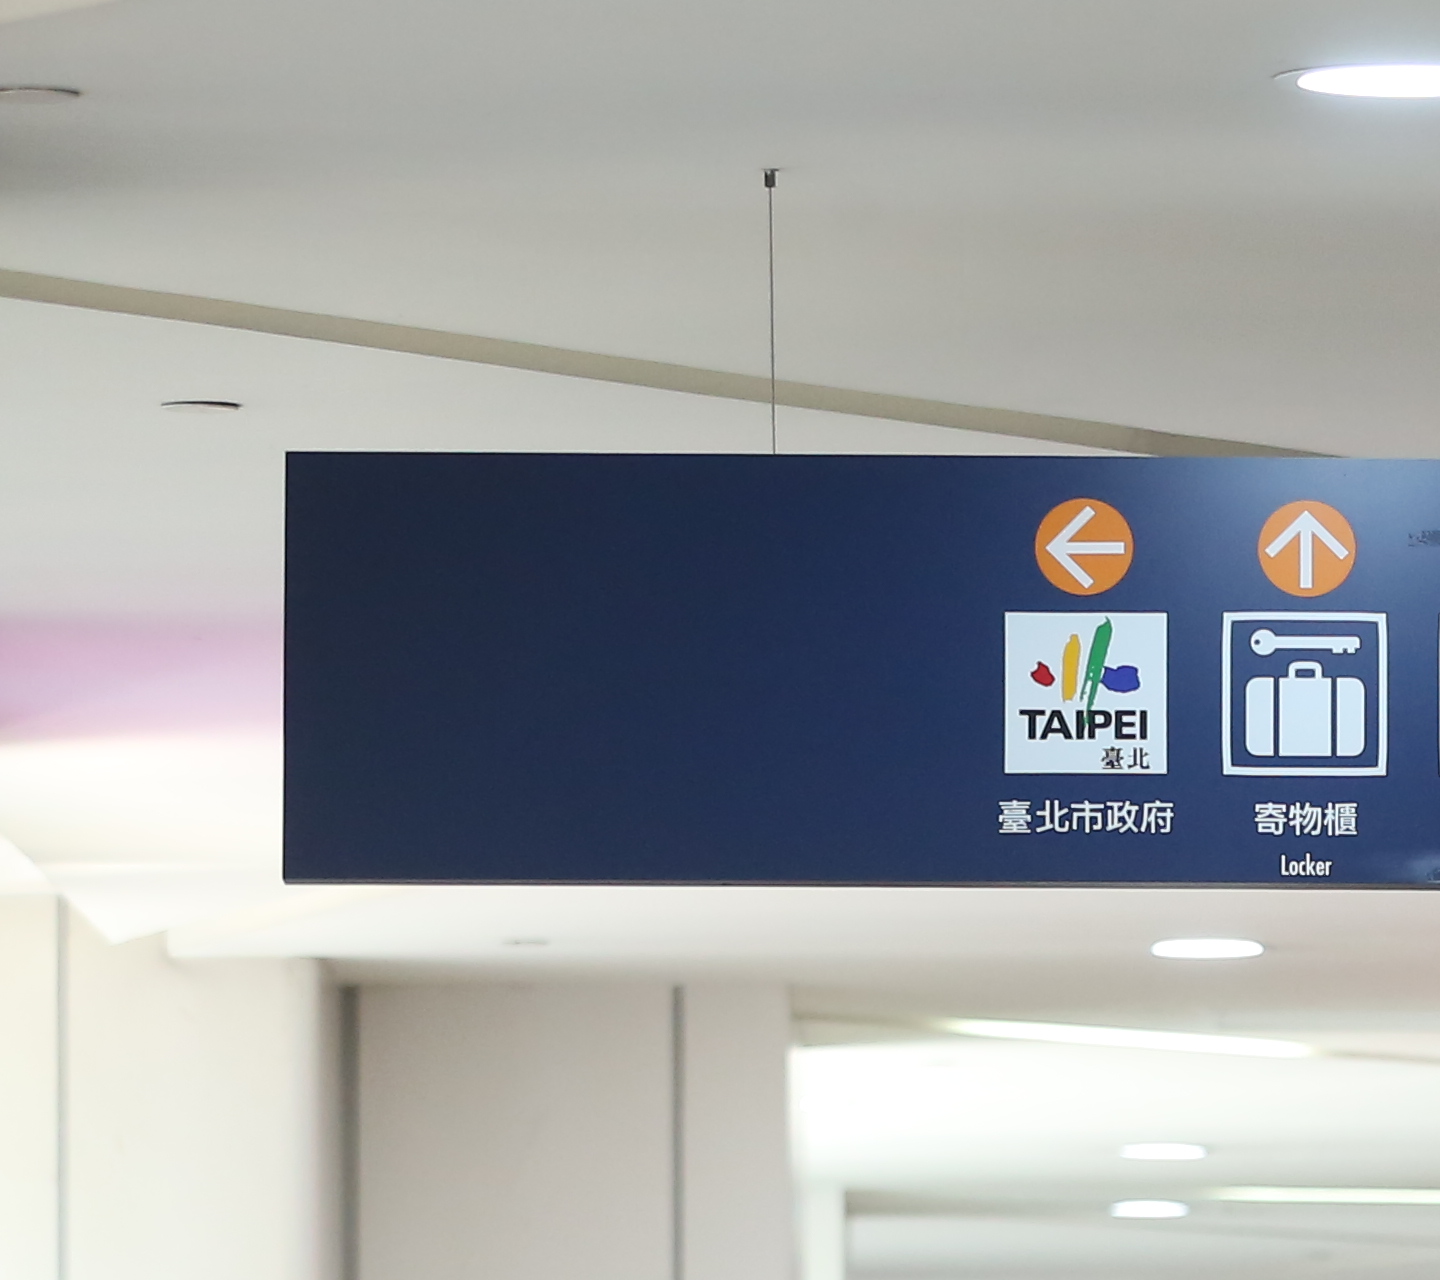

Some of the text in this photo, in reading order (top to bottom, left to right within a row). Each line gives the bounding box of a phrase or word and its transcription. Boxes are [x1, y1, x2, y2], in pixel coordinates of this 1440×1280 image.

[1019, 709, 1148, 741] TAIPEI
[1100, 745, 1151, 771] 臺北
[997, 799, 1174, 836] 臺北市政府
[1253, 801, 1359, 837] 寄物櫃
[1280, 853, 1332, 877] Locker
